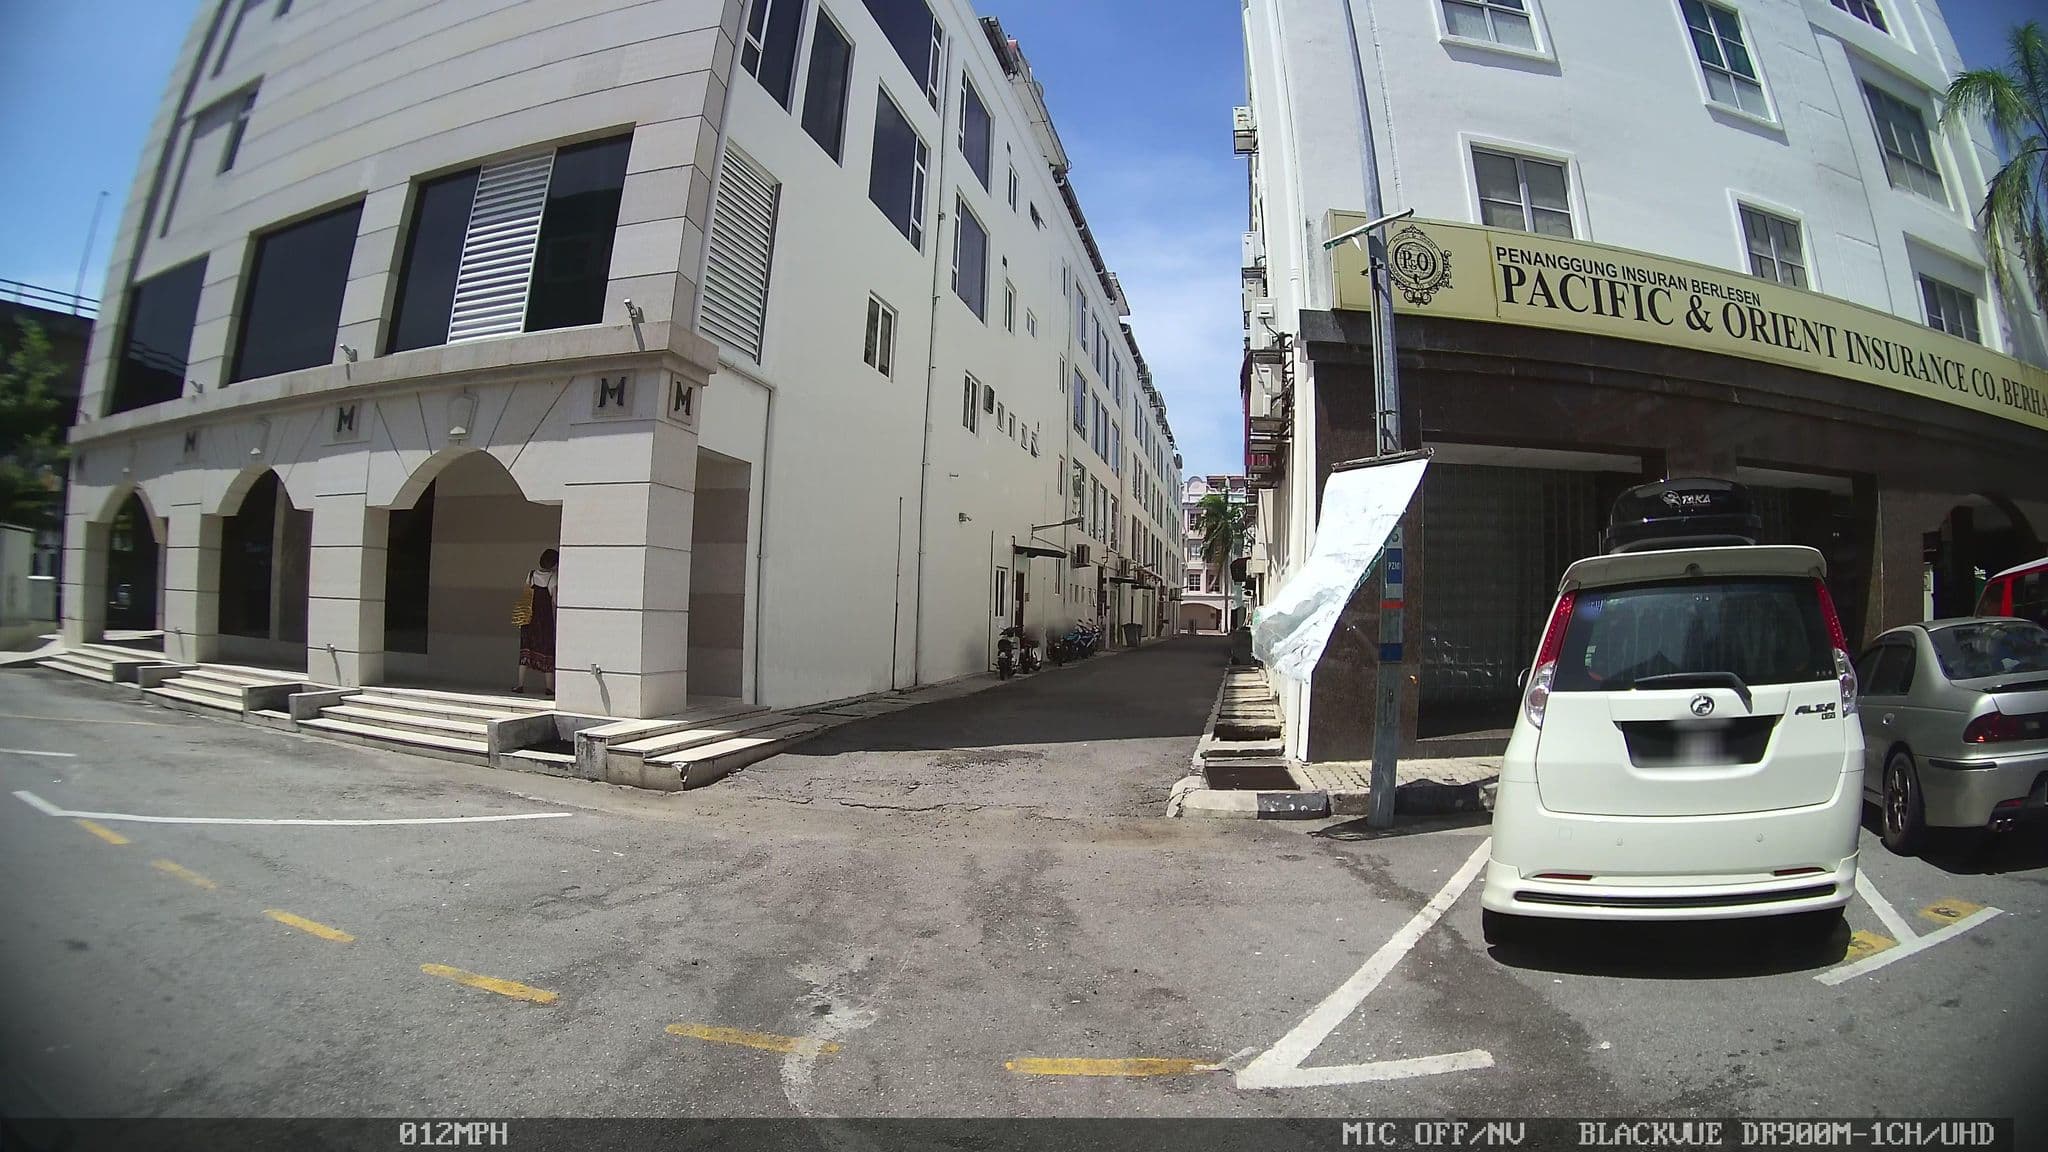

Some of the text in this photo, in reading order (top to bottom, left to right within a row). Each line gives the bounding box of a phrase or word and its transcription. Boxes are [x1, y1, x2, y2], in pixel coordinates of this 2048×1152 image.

[1496, 246, 1761, 307] PENANGGUNG INSURAN BERLESEN
[1498, 263, 1675, 326] PACIFIC
[1685, 294, 1714, 334] &
[1722, 302, 1837, 359] ORIENT
[1843, 329, 1969, 393] INSURANCE
[1971, 367, 2001, 404] CO.
[597, 376, 626, 408] M
[674, 380, 693, 416] M
[336, 406, 355, 433] M
[1681, 494, 1711, 505] TAKA
